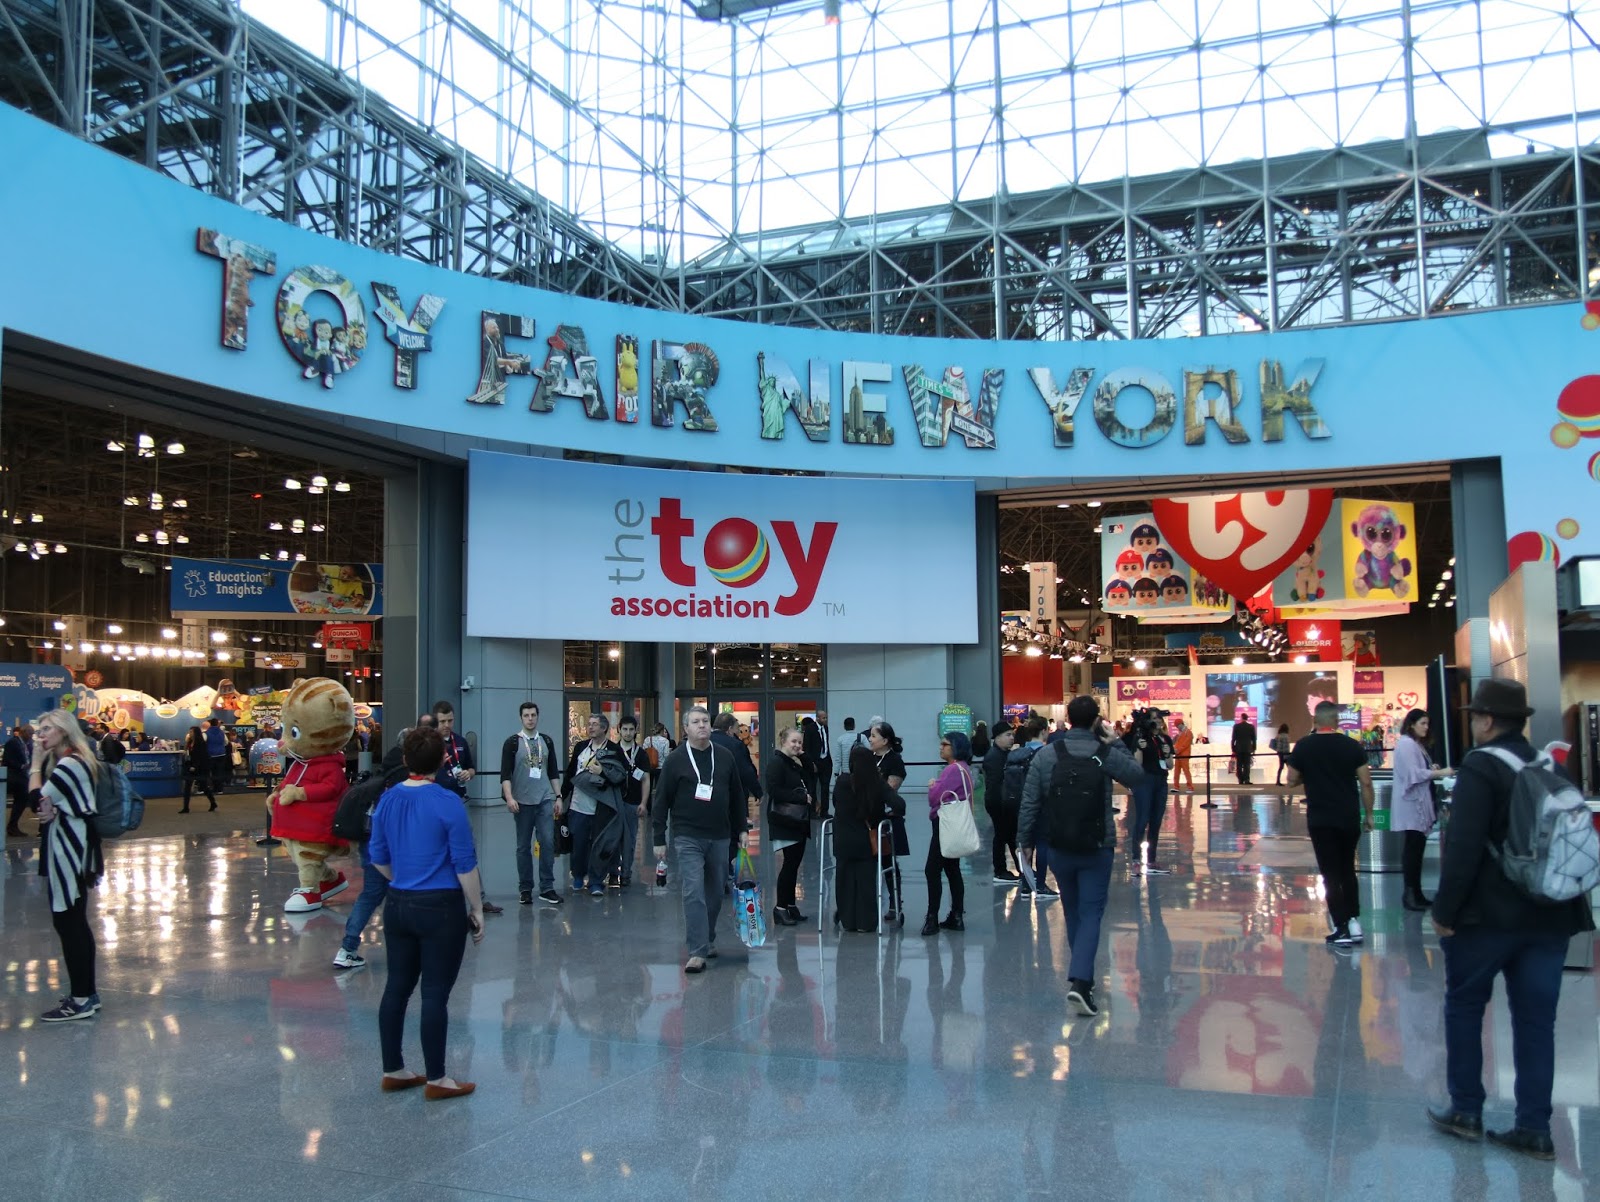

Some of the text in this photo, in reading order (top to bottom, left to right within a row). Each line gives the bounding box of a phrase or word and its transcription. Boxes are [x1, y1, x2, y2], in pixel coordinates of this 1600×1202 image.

[196, 227, 1333, 450] TOY FAIR NEW YORK
[398, 330, 426, 349] WELCOME
[921, 379, 944, 394] TIMES
[958, 420, 972, 431] ONE
[604, 498, 645, 585] the
[1168, 489, 1310, 571] ty
[651, 497, 839, 616] toy
[216, 583, 263, 598] Insights
[610, 593, 770, 618] association
